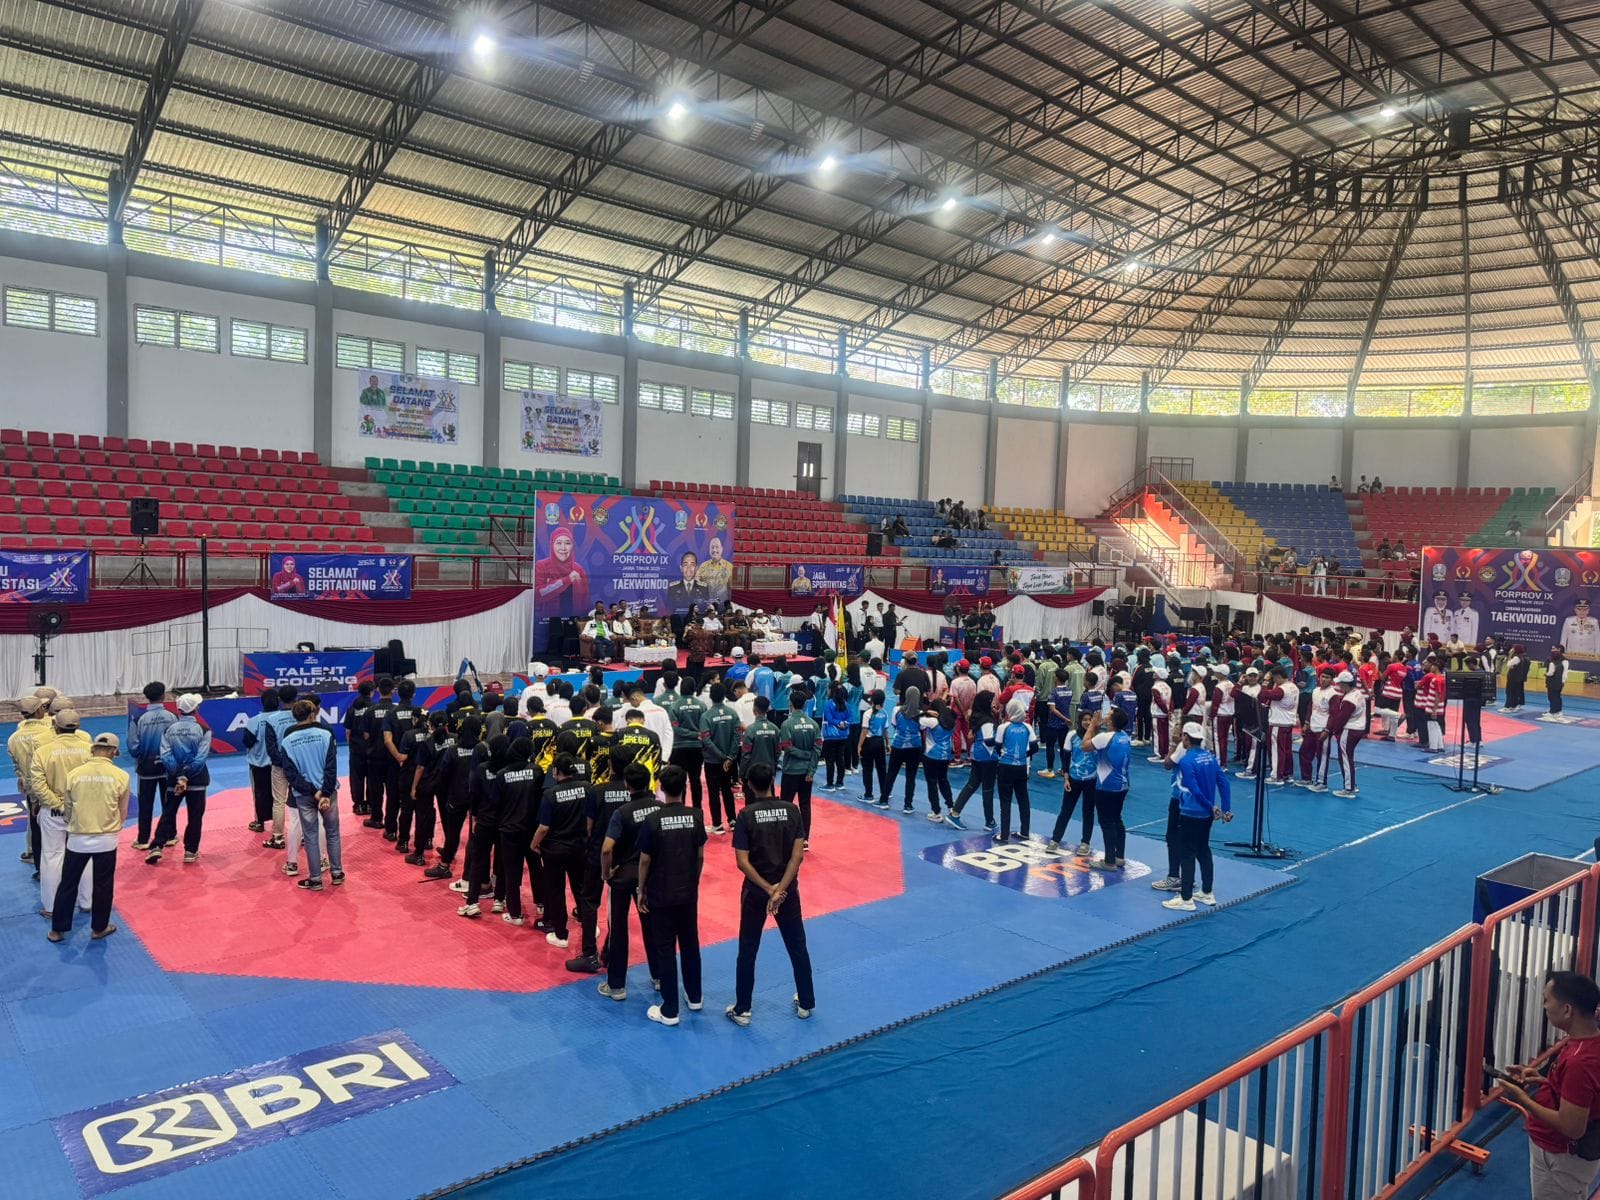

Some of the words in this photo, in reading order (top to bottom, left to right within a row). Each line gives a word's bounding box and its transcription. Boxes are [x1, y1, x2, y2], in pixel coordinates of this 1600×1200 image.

[389, 385, 435, 398] SELAMAT
[393, 395, 431, 407] DATANG
[544, 405, 581, 416] SELAMAT
[546, 415, 579, 425] DATANG
[612, 554, 658, 565] PORPROV
[660, 555, 669, 565] IX
[308, 567, 359, 579] SELAMAT
[308, 579, 376, 591] BERTANDING
[612, 578, 669, 590] TAEKWONDO
[1495, 590, 1542, 600] PORPROV
[1544, 592, 1554, 601] IX
[1490, 611, 1557, 625] TAEKWONDO
[275, 666, 346, 677] TALENT
[504, 769, 533, 779] SURABAYA
[556, 787, 585, 799] SURABAYA
[604, 790, 631, 798] SURABAY
[755, 808, 787, 818] SURABAYA
[660, 815, 694, 825] SURABAYA
[224, 1042, 430, 1129] BRI
